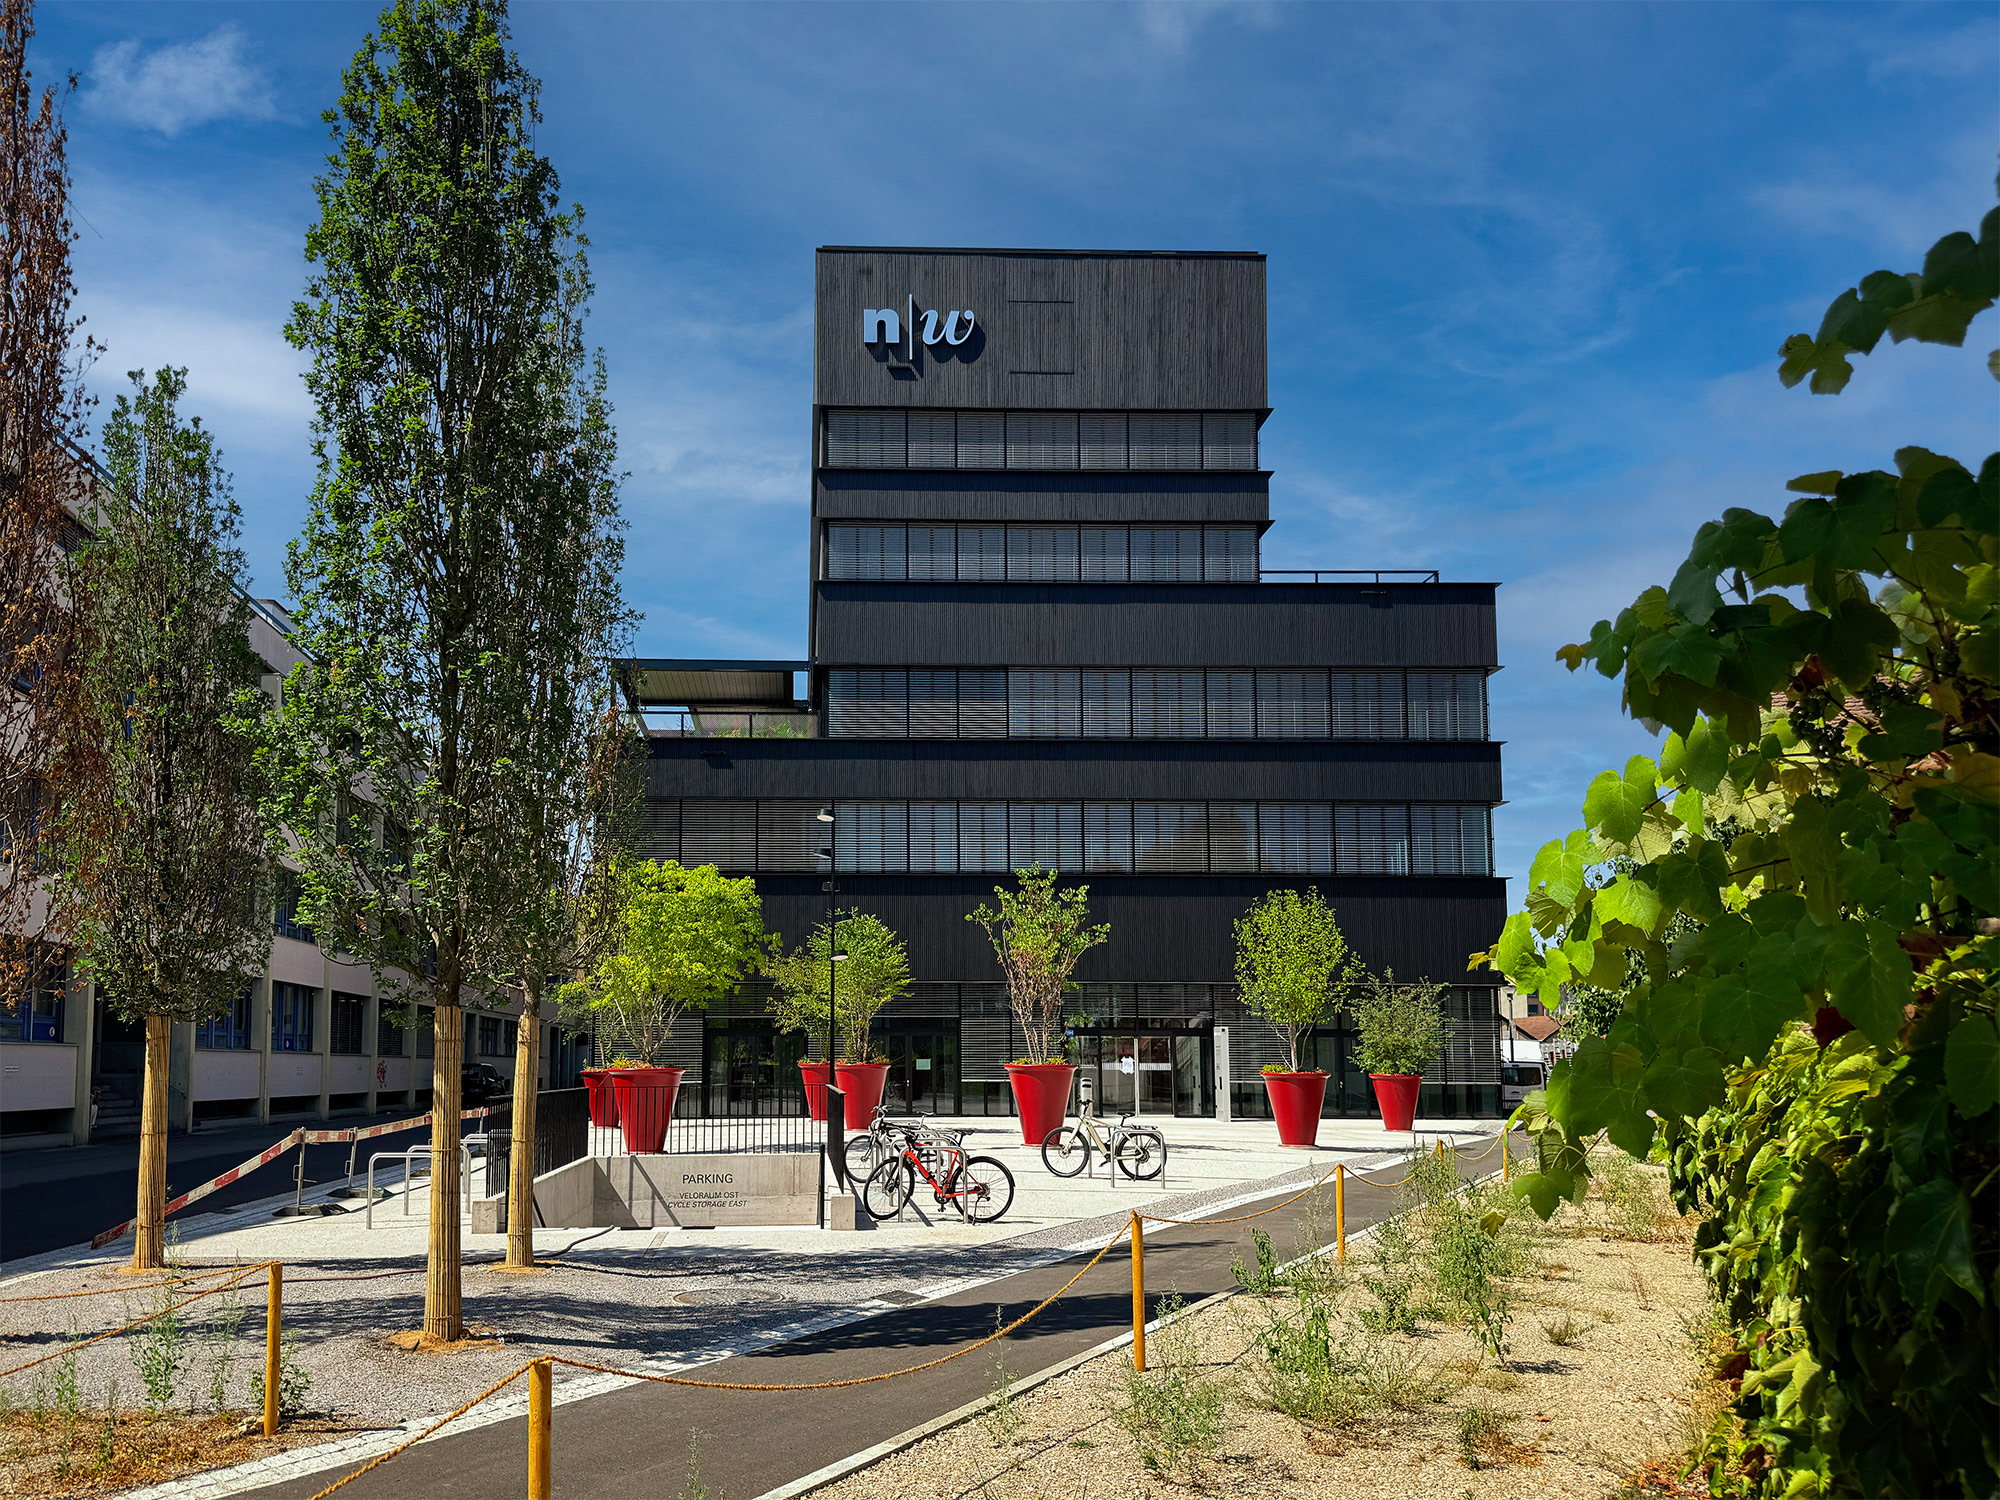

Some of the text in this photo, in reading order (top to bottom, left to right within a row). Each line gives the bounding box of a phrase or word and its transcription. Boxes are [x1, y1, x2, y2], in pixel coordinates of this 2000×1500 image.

[682, 1173, 733, 1184] PARKING
[723, 1191, 740, 1199] OST
[692, 1200, 727, 1208] STORAGE
[728, 1200, 747, 1208] EAST
